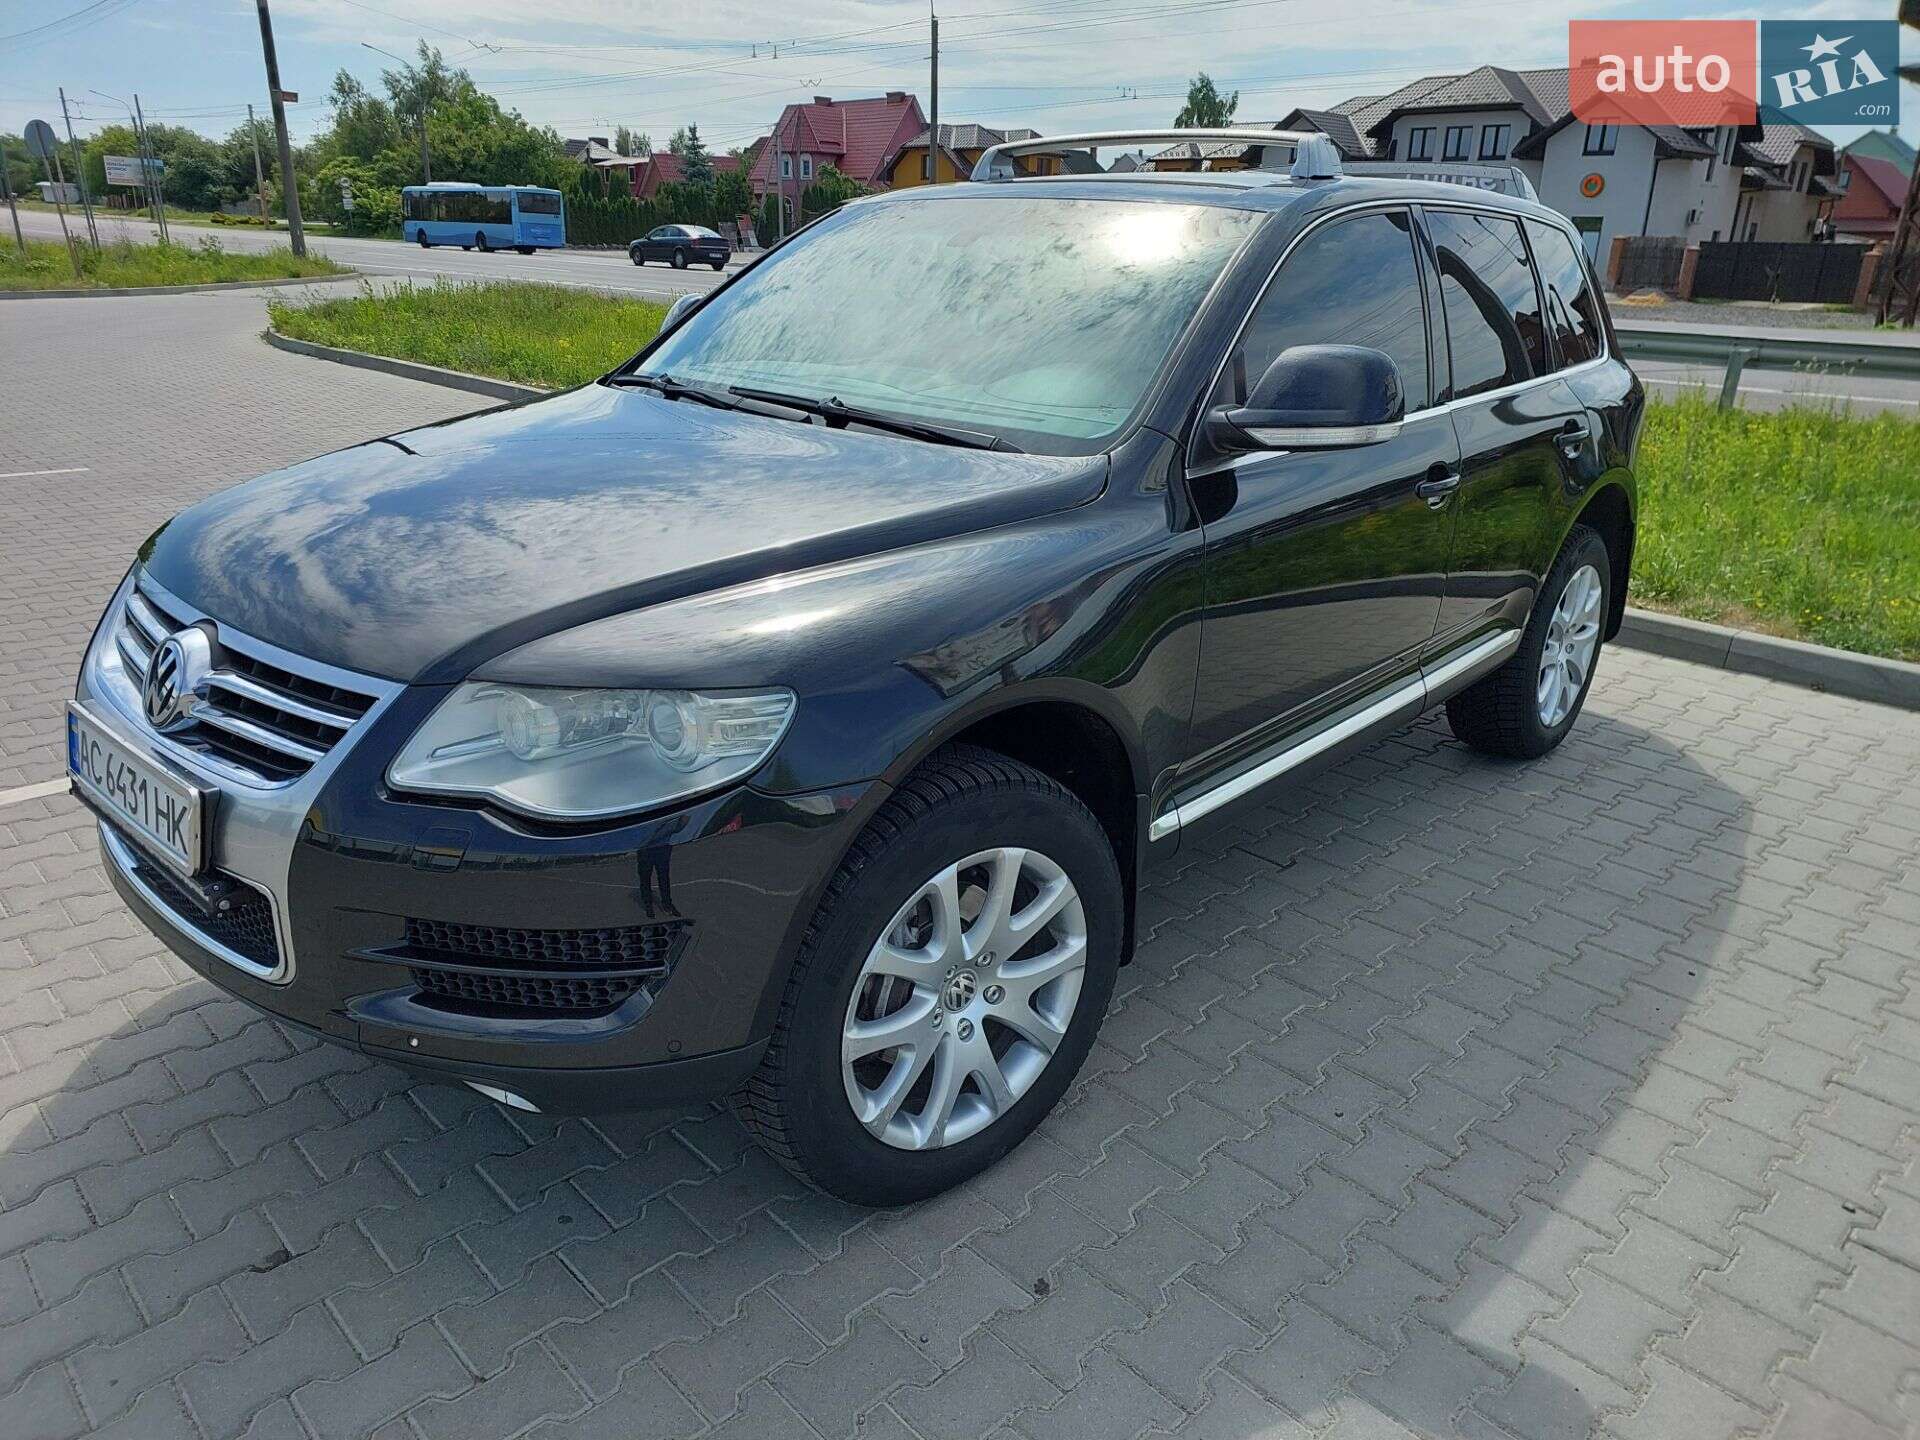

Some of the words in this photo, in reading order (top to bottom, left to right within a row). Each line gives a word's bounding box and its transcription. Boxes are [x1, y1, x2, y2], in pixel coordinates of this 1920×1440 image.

[80, 730, 103, 785] AC
[105, 753, 149, 826] 6431
[154, 786, 188, 855] HK
